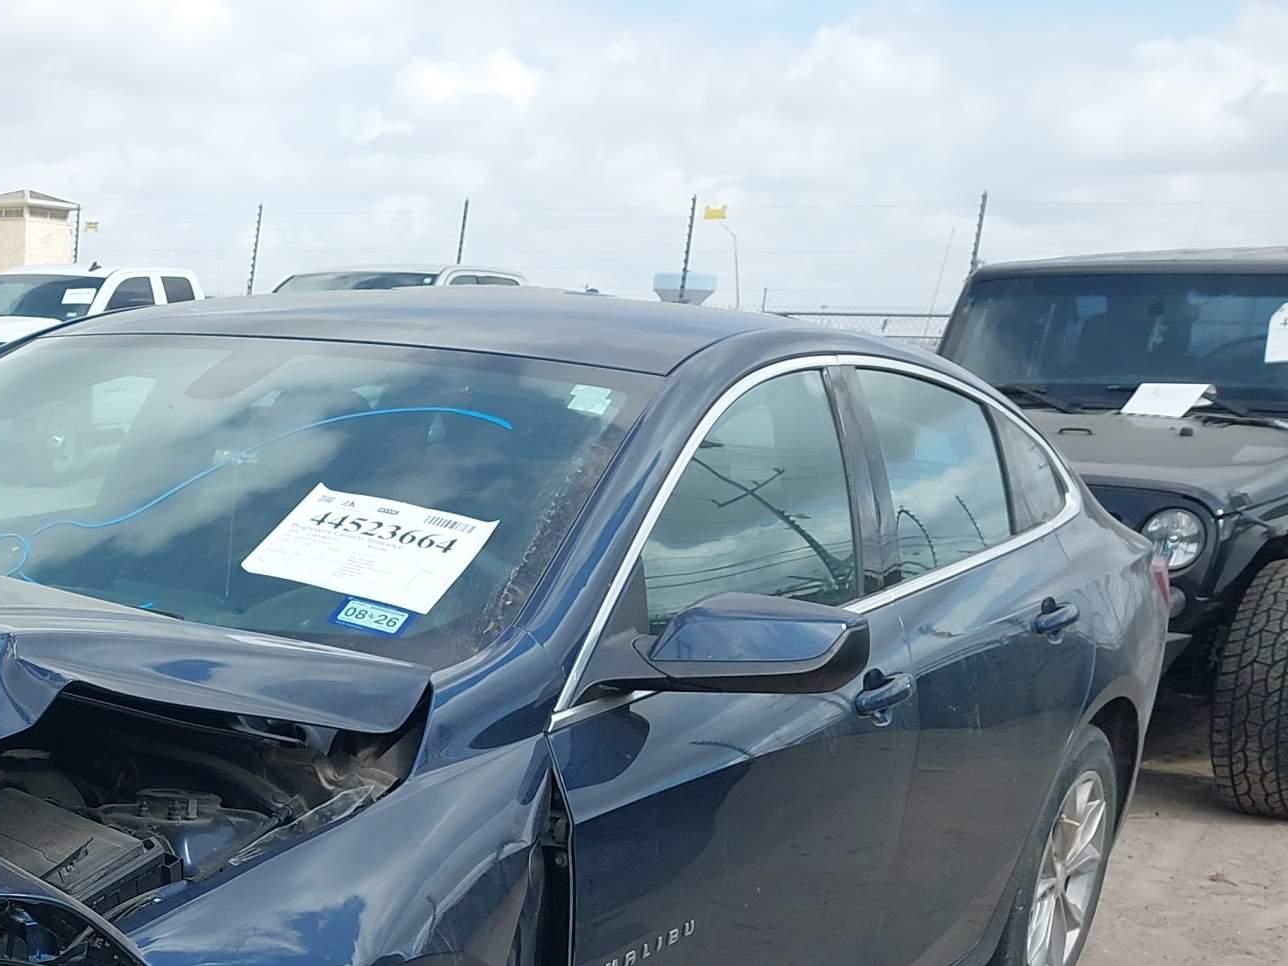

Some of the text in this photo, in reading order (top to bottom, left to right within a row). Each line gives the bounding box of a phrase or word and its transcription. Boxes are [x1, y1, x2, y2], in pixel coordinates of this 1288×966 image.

[310, 511, 459, 554] 44523664
[344, 606, 401, 628] 08 26
